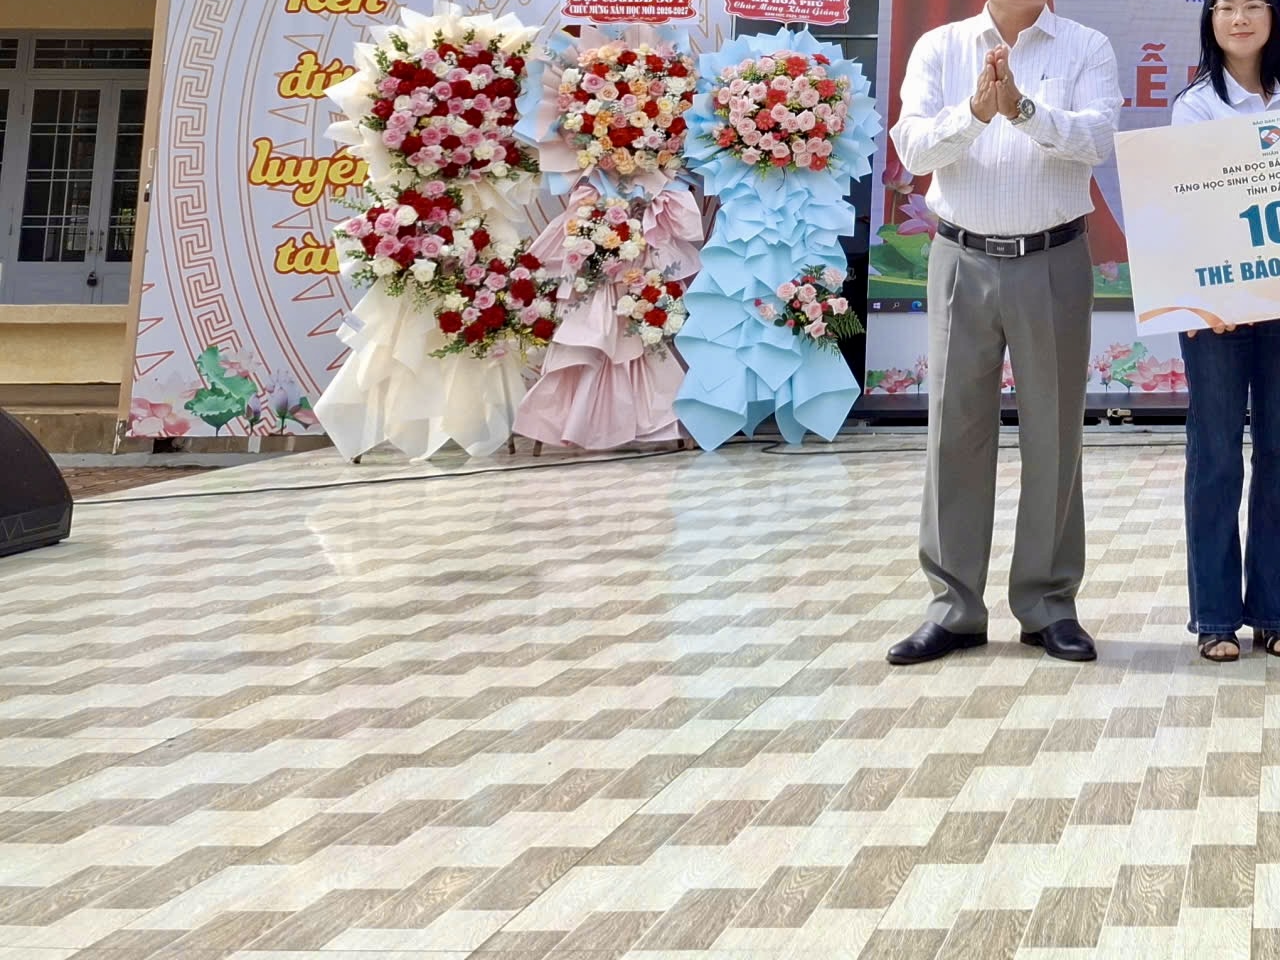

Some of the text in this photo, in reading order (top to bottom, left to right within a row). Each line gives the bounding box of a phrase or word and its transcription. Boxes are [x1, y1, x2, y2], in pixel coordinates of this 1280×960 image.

[278, 50, 358, 100] đứ
[1222, 164, 1242, 176] BẠN
[1244, 160, 1266, 174] ĐỌC
[1174, 182, 1200, 195] TẶNG
[1203, 178, 1225, 192] HỌC
[1227, 175, 1249, 187] SINH
[1251, 171, 1266, 183] CÓ
[1247, 184, 1268, 196] TỈNH
[1195, 259, 1233, 287] THẺ
